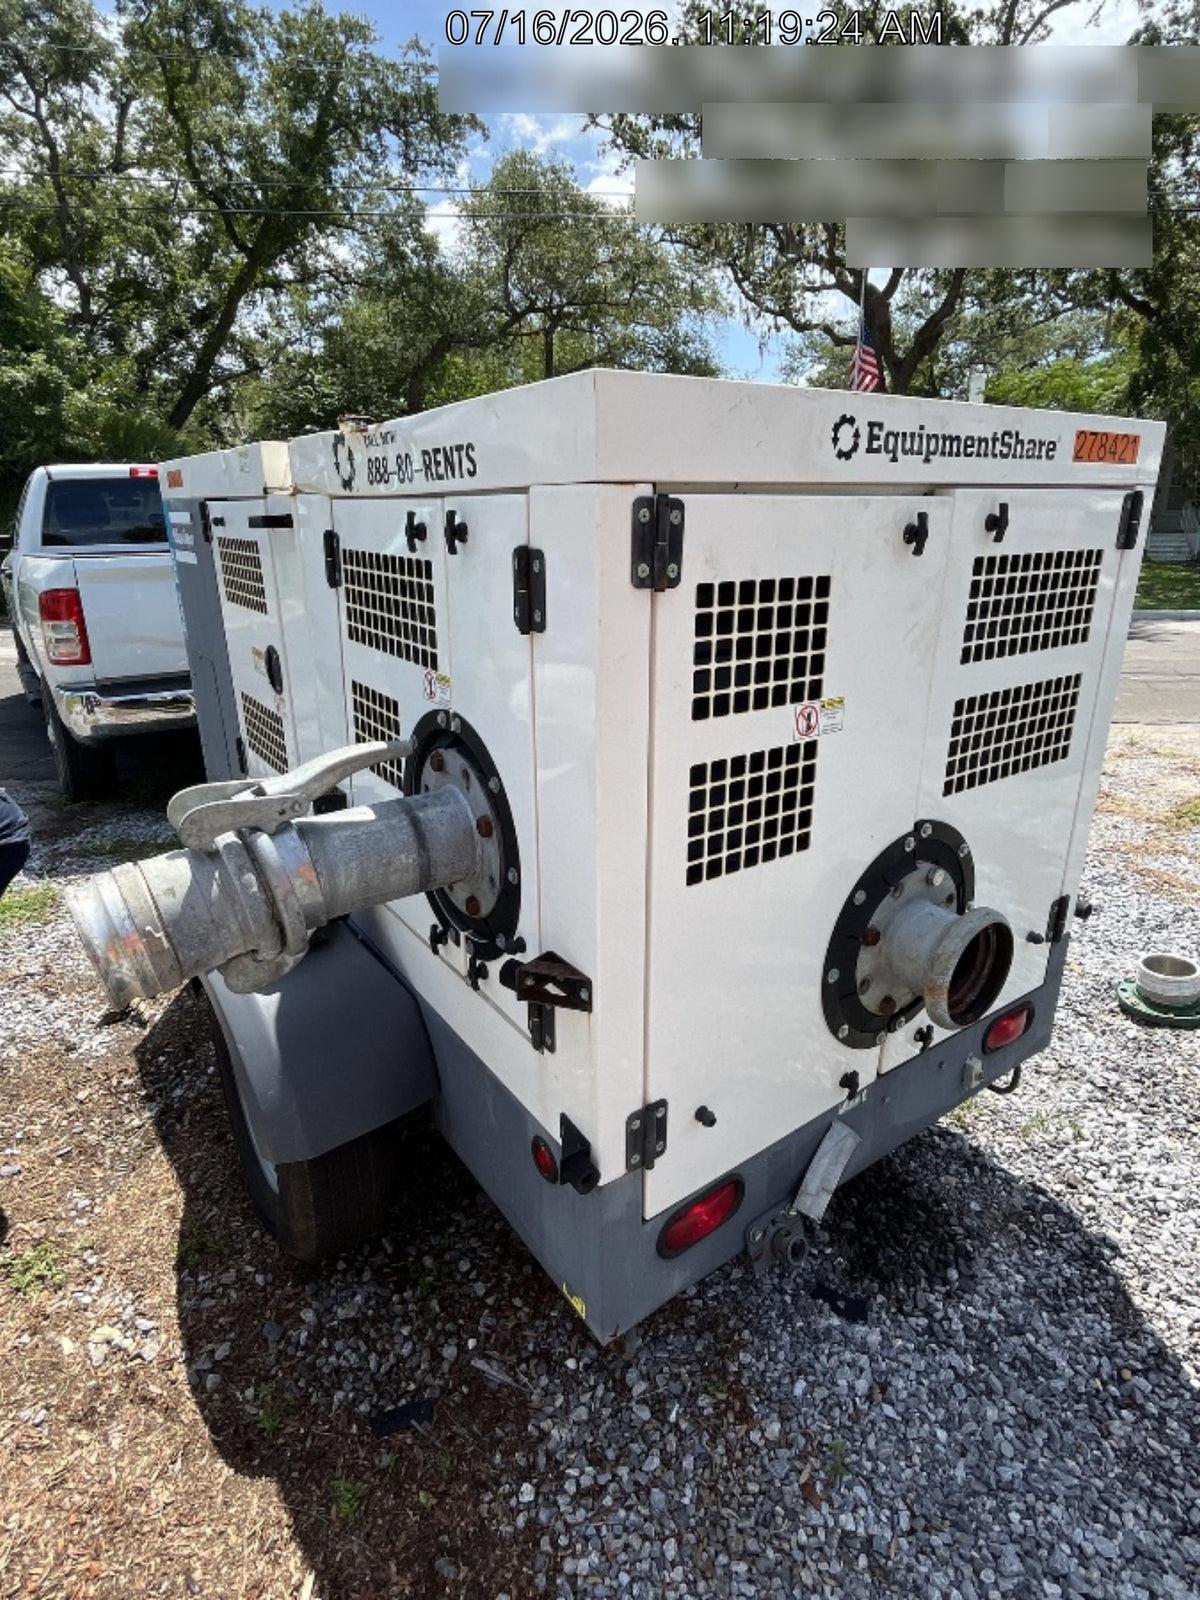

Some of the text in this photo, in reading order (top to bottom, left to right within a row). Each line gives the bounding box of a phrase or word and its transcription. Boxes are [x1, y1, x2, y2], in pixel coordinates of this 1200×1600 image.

[367, 442, 477, 485] 888-80-RENTS
[865, 420, 1058, 464] EquipmentShare
[1073, 430, 1140, 463] 278421
